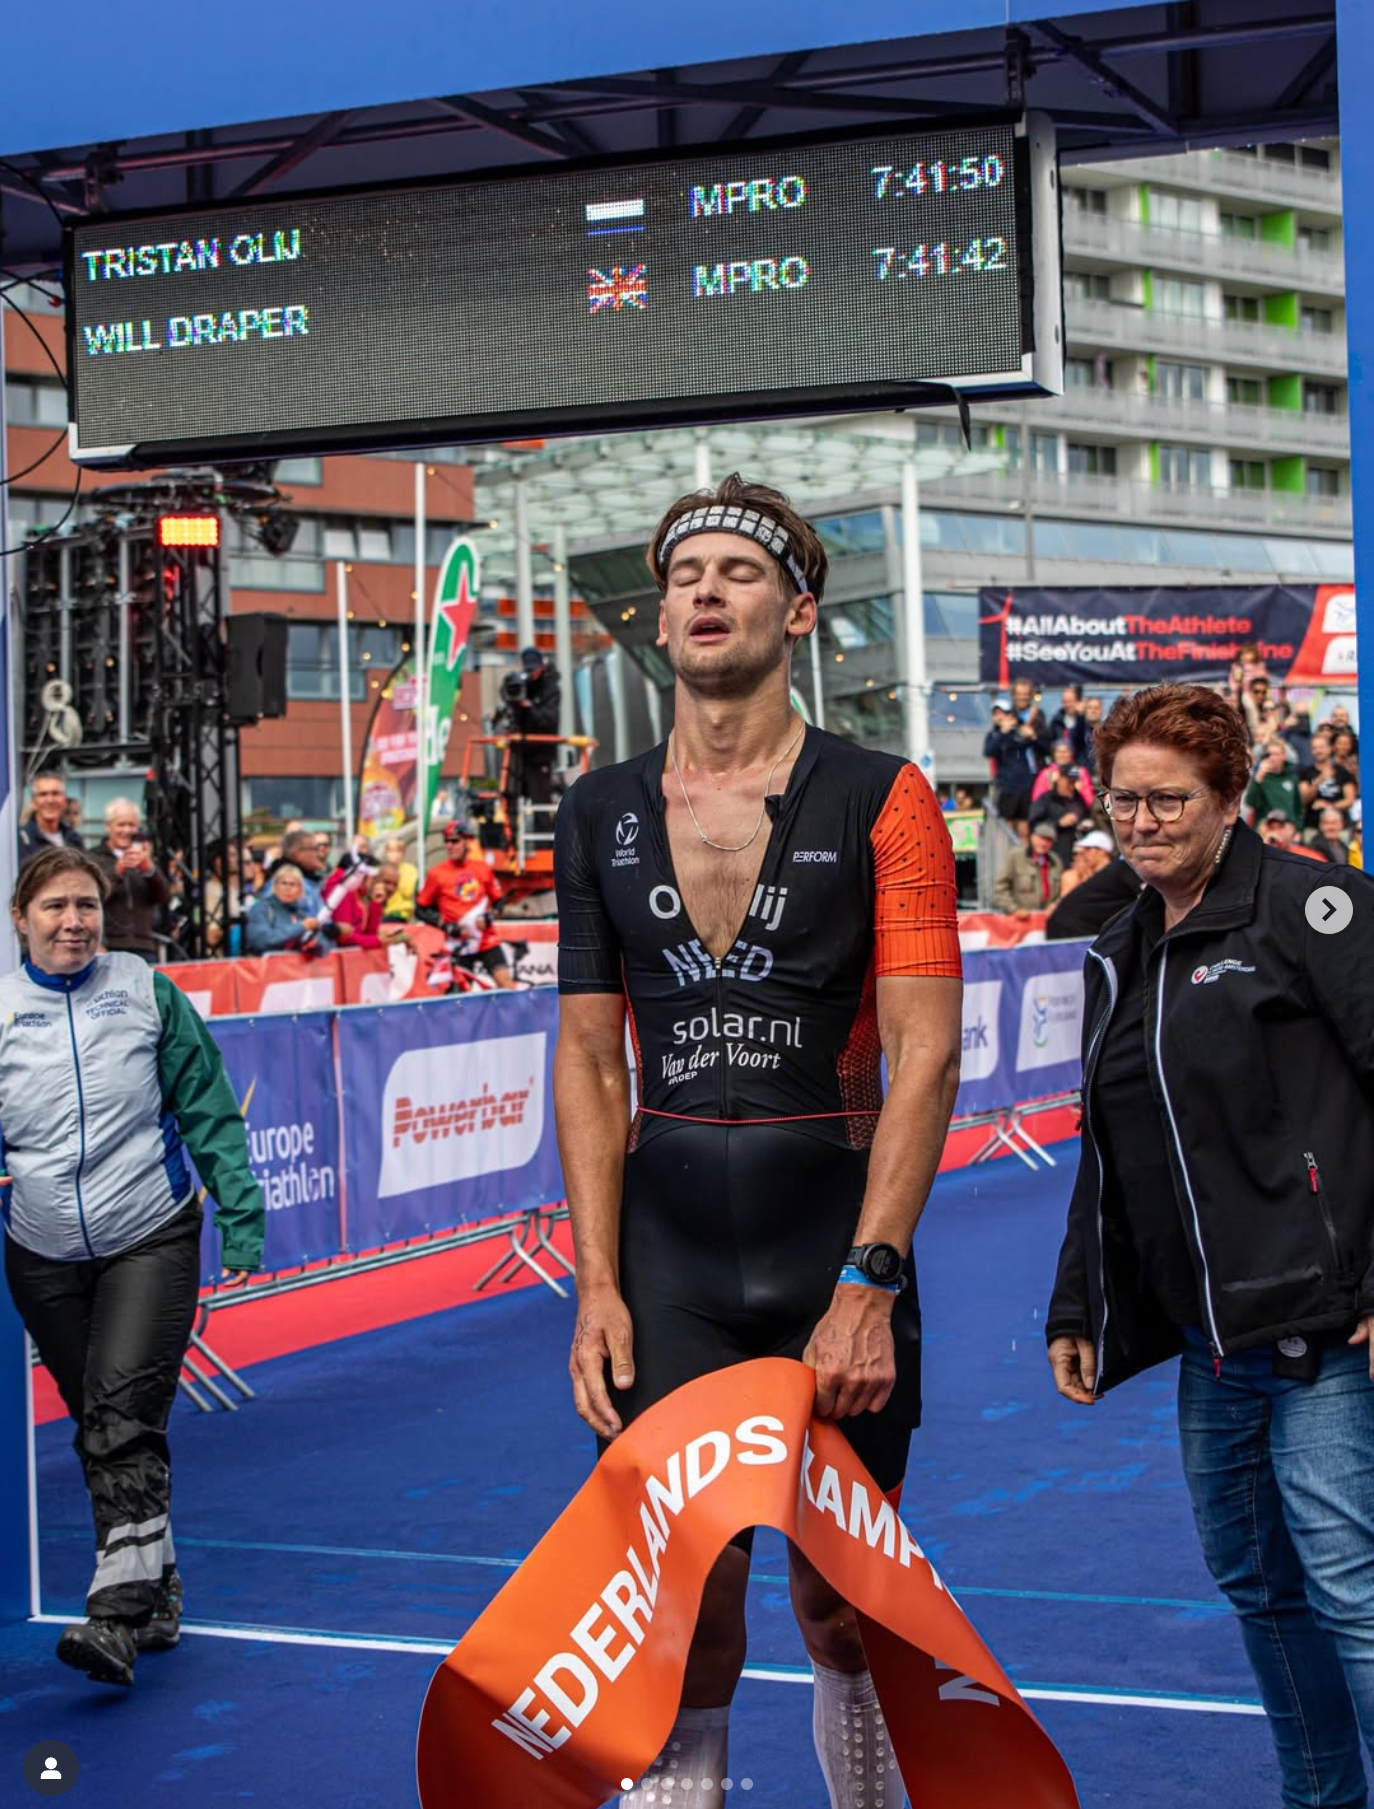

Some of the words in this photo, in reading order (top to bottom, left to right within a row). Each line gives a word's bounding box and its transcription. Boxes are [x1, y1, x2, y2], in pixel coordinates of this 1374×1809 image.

[80, 237, 221, 282] TRISTAN
[689, 175, 808, 217] MPRO
[870, 153, 1005, 198] 7:41:50
[83, 320, 162, 356] WILL
[167, 305, 309, 348] DRAPER
[692, 256, 811, 297] MPRO
[871, 238, 1007, 279] 7:41:42
[1005, 614, 1252, 636] #AllAboutTheAthlete
[615, 847, 636, 858] World
[792, 850, 838, 863] PERFORM
[672, 1006, 803, 1049] solar.nl
[661, 1053, 685, 1080] Van
[688, 1044, 720, 1070] der
[725, 1042, 782, 1070] Voort
[245, 1121, 315, 1165] urope
[491, 1414, 788, 1761] NEDERLANDS
